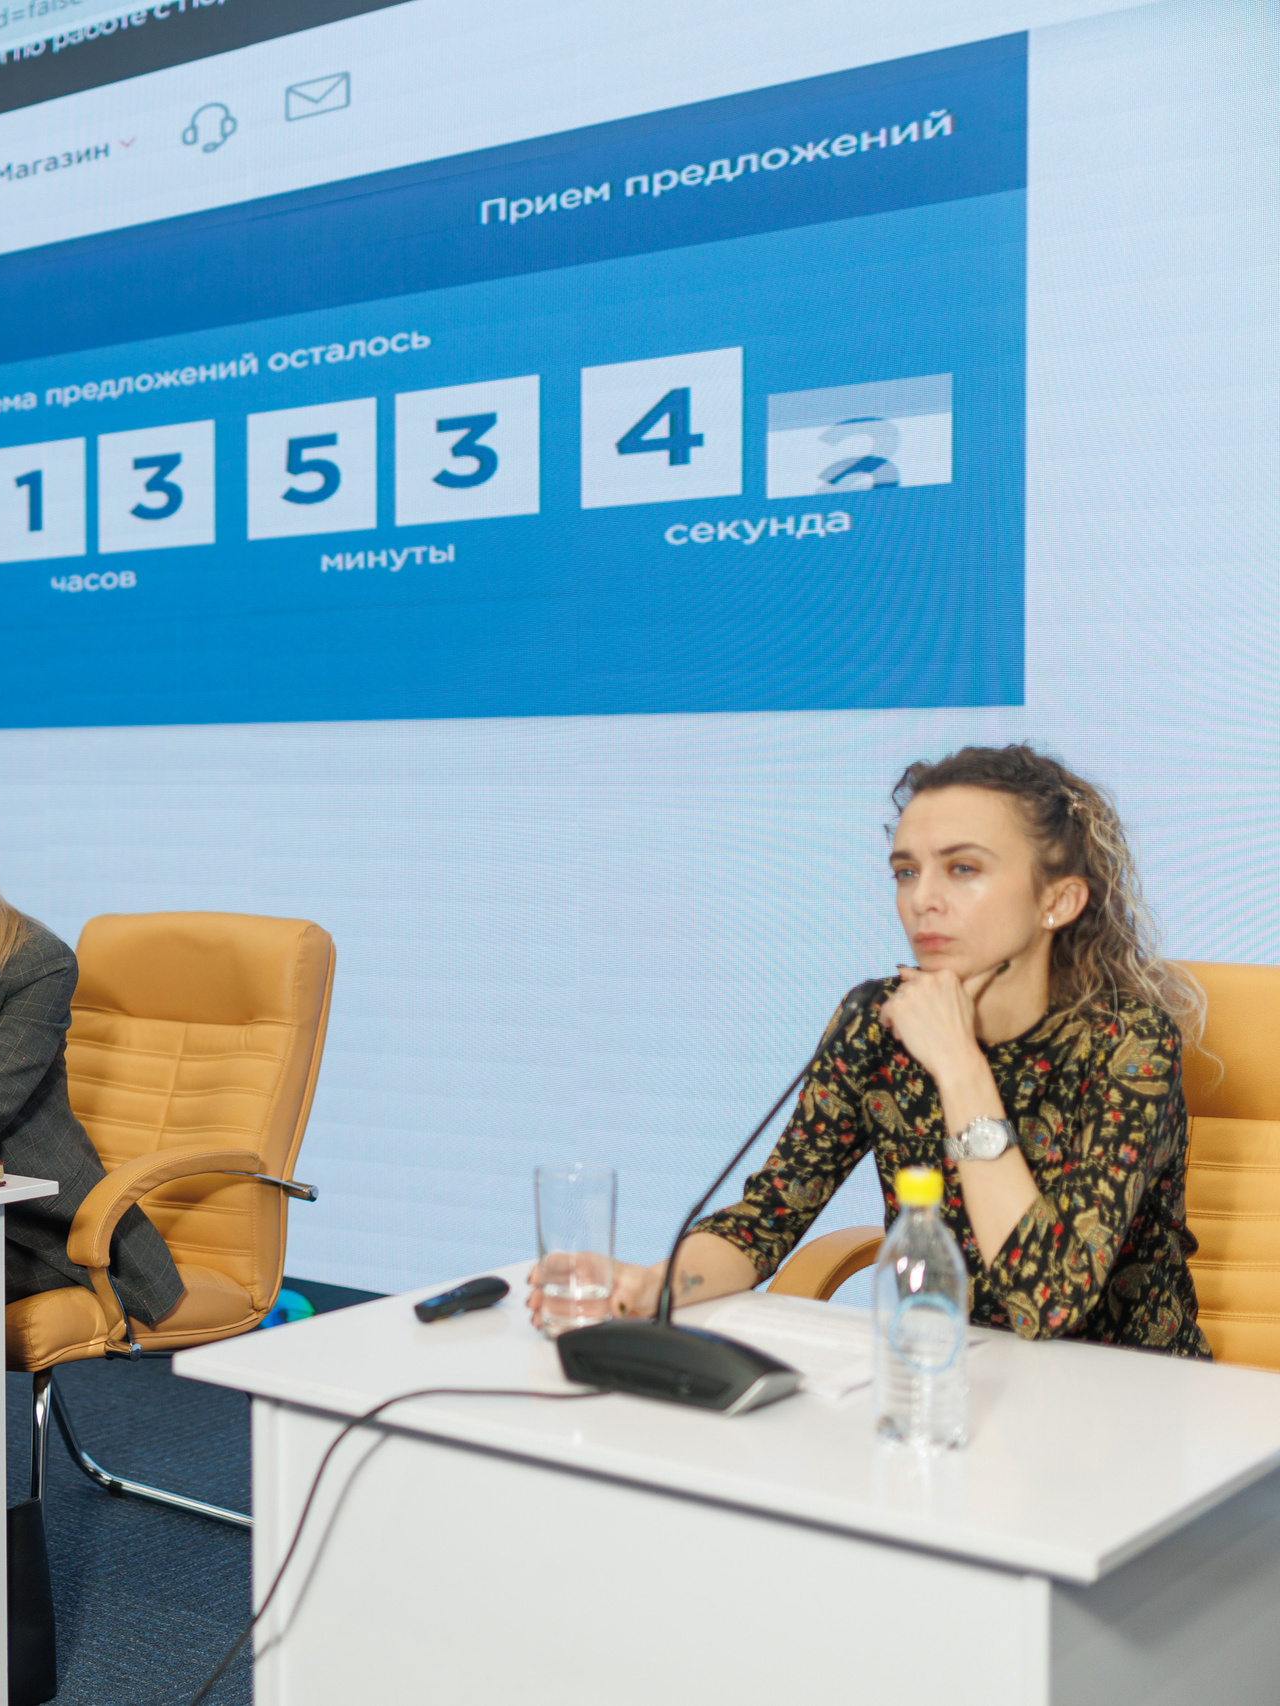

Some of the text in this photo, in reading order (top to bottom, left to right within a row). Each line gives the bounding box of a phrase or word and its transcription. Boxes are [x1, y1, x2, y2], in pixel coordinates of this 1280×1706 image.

[479, 108, 954, 225] Прием предложений
[45, 352, 260, 412] предложений
[267, 328, 431, 373] осталось
[664, 507, 853, 547] секунда
[320, 542, 456, 574] минуты
[51, 567, 137, 594] часов
